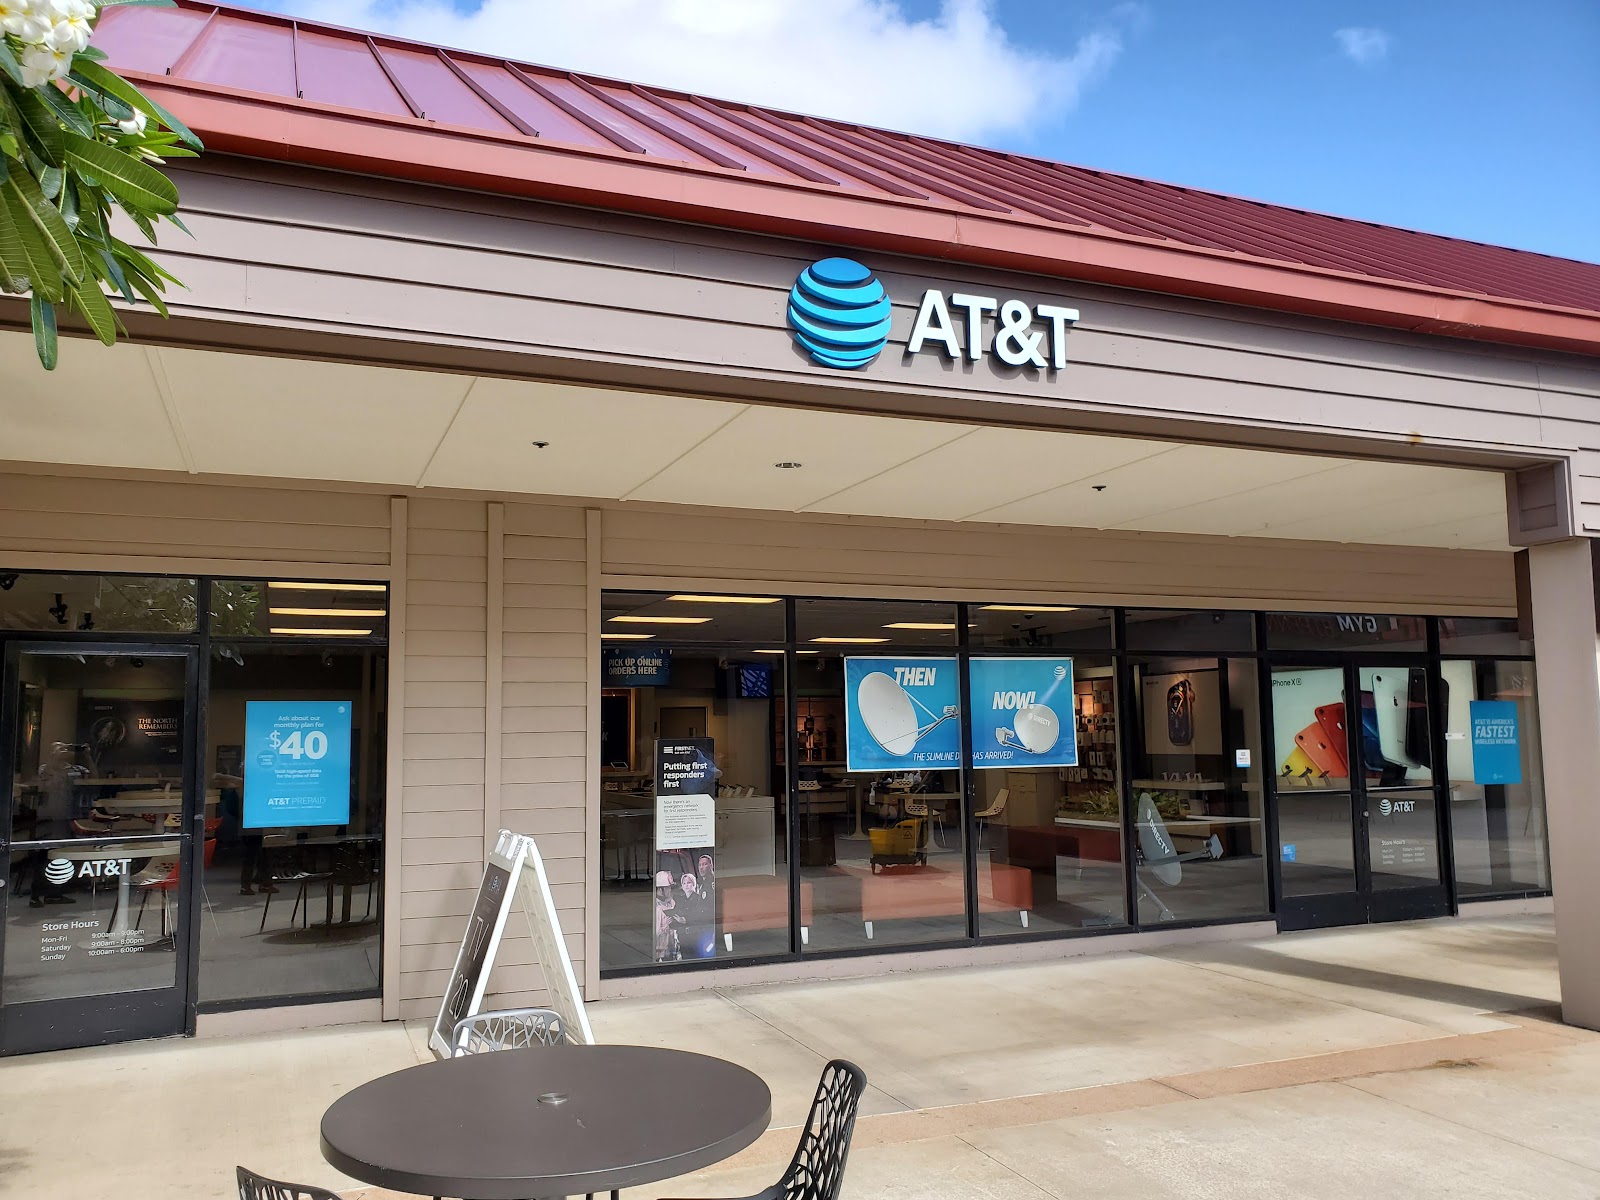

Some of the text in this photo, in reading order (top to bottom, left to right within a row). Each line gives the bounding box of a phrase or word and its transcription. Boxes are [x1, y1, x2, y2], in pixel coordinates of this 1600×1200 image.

[907, 289, 1080, 370] AT&T
[608, 658, 663, 667] PICK UP ONLINE
[608, 666, 658, 676] ORDERS HERE
[893, 666, 937, 686] THEN
[992, 691, 1036, 710] NOW!
[1475, 726, 1515, 738] FASTEST
[269, 730, 328, 760] $40
[913, 752, 925, 761] THE
[926, 752, 954, 761] SLIMLINE
[972, 751, 984, 760] HAS
[984, 750, 1014, 760] ARRIVED!
[663, 762, 708, 772] Putting first
[663, 771, 705, 780] responders
[663, 780, 680, 788] first
[268, 796, 326, 806] AT&T PREPAID
[1393, 801, 1416, 812] AT&T
[1148, 818, 1170, 855] DIRECTV
[78, 858, 132, 878] AT&T
[42, 920, 100, 932] Store Hours
[41, 935, 68, 944] Mon-Fri
[468, 915, 490, 962] TV
[40, 944, 72, 952] Saturday
[40, 953, 66, 962] Sunday
